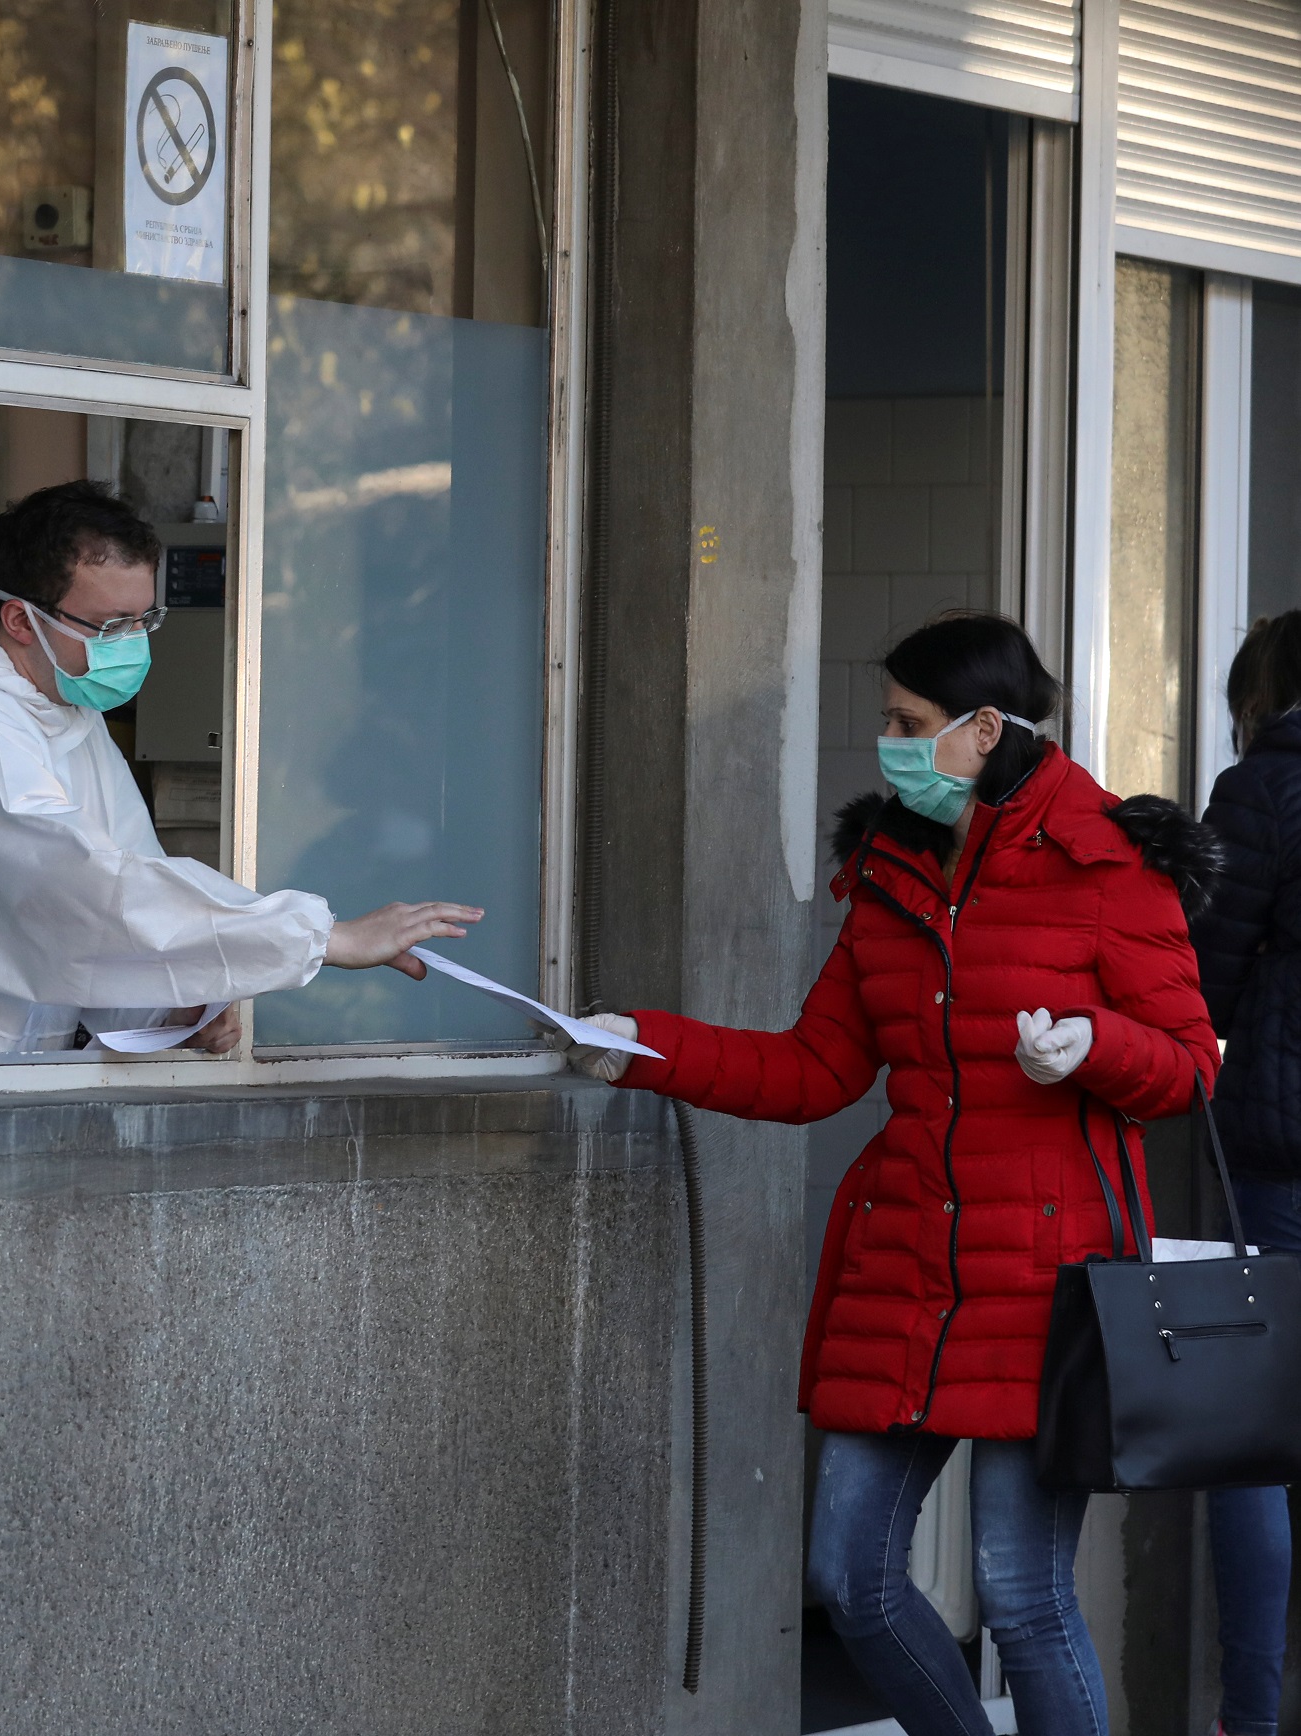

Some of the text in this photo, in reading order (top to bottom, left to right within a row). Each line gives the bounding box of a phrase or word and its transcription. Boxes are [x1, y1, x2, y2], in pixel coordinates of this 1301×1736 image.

[146, 36, 211, 55] ЗАБРАЊЕНО ПУШЕЊЕ
[145, 219, 178, 233] РЕПУБКА
